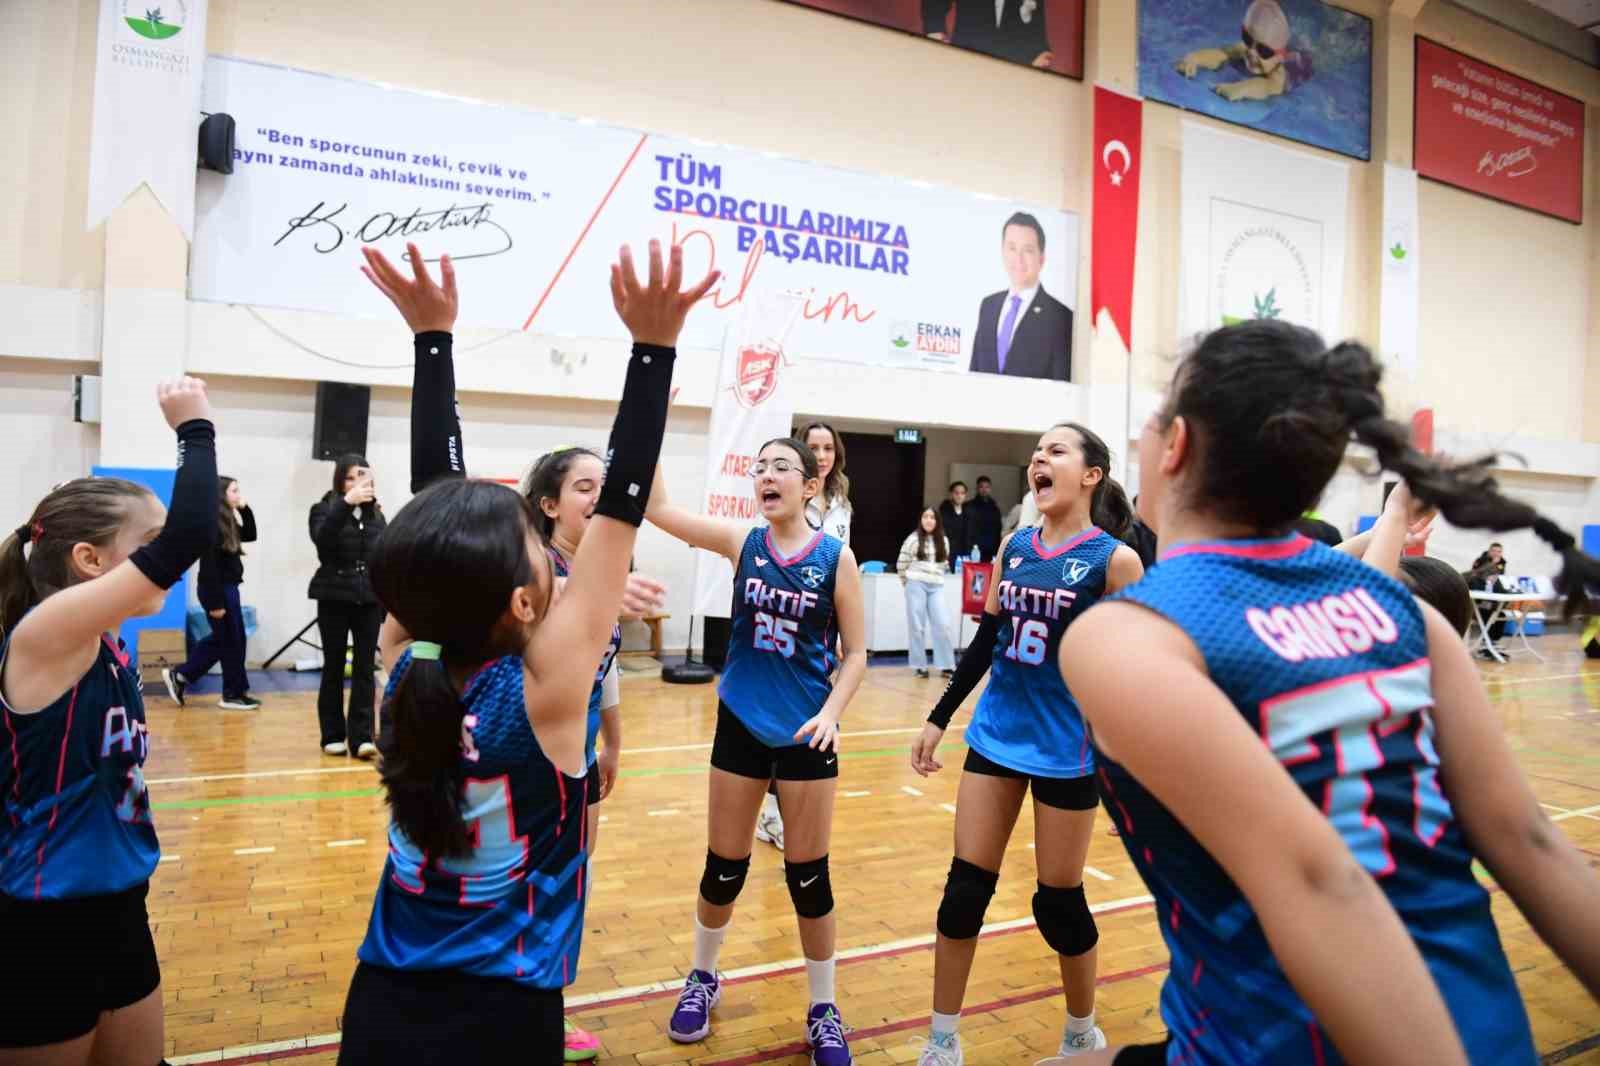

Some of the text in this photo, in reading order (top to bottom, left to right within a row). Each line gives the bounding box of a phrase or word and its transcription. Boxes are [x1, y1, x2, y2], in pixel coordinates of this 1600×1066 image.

[232, 148, 273, 165] aynı
[279, 155, 364, 177] zamanda
[369, 166, 461, 191] ahlaklısını
[310, 138, 406, 162] sporcunun
[412, 154, 453, 171] zeki,
[458, 161, 503, 177] çevik
[508, 169, 528, 181] ve
[655, 153, 722, 189] TÜM
[654, 185, 910, 249] SPORCULARIMIZA
[737, 225, 910, 276] BAŞARILAR
[917, 322, 961, 338] ERKAN
[448, 435, 461, 471] KIPSTA
[707, 493, 736, 517] SPOR
[753, 611, 799, 659] 25
[1005, 616, 1049, 666] 16
